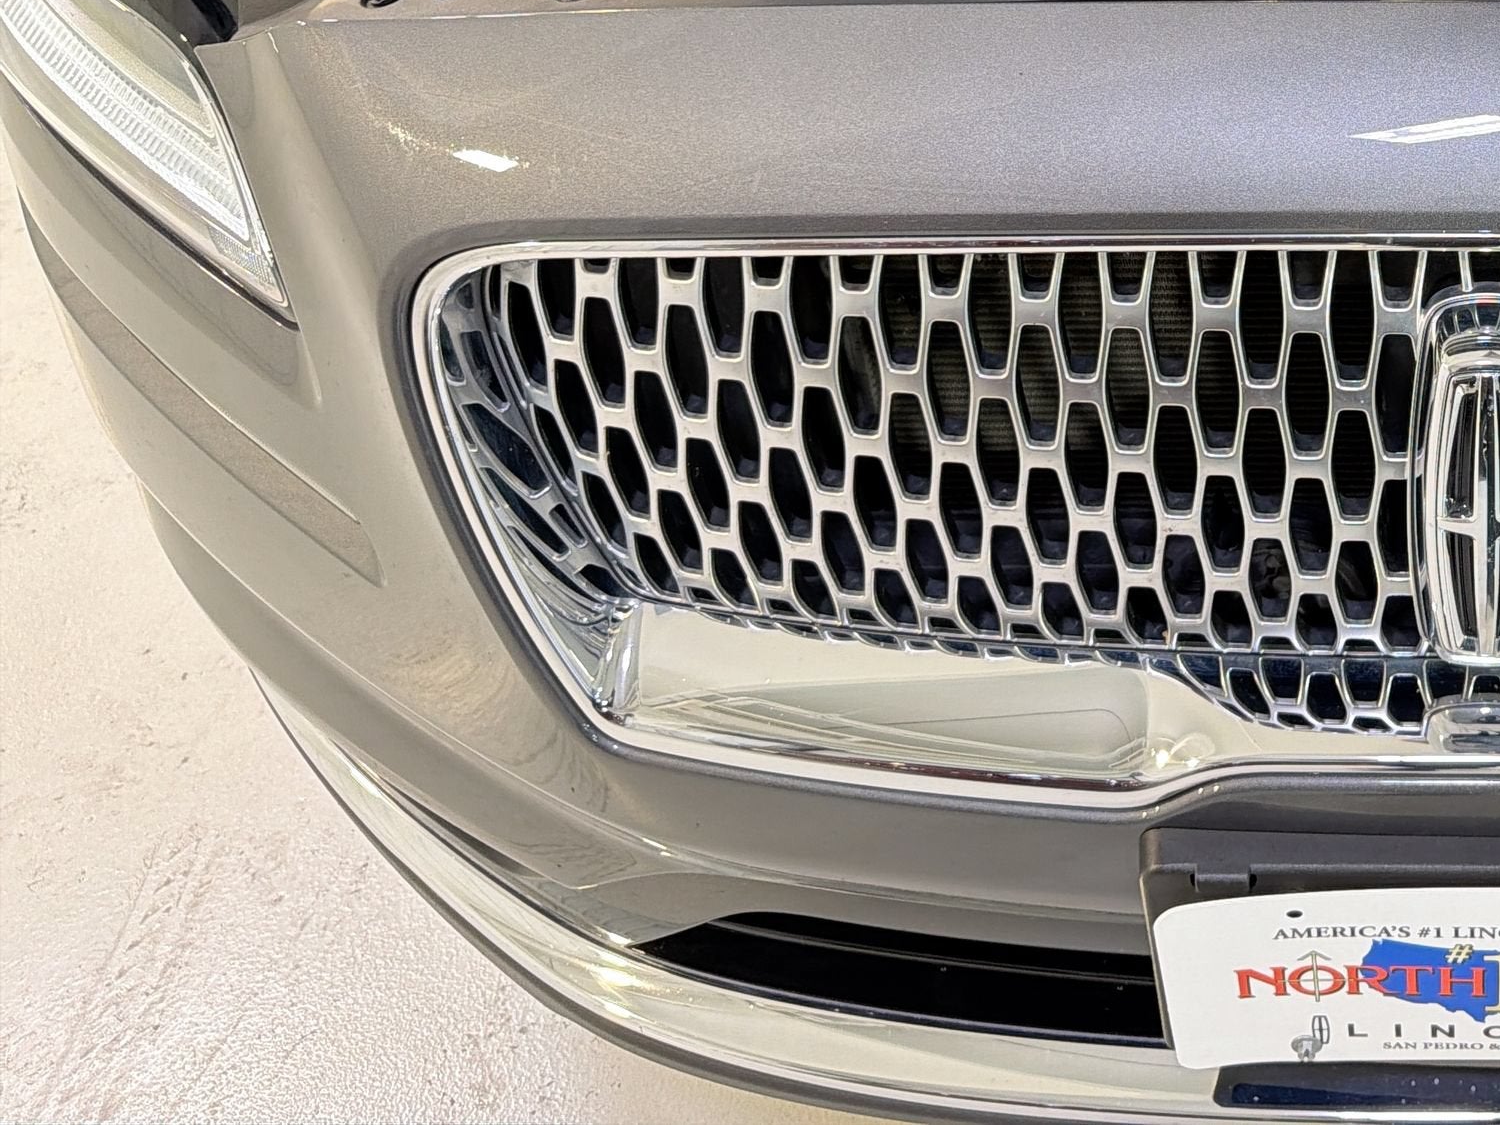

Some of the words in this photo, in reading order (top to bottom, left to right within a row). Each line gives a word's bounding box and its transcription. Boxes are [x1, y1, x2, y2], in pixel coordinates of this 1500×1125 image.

[1272, 925, 1411, 940] AMERICA'S
[1417, 926, 1443, 939] #1
[1234, 964, 1488, 999] NORTH
[1383, 1041, 1418, 1051] SAN
[1423, 1041, 1484, 1051] PEDRO
